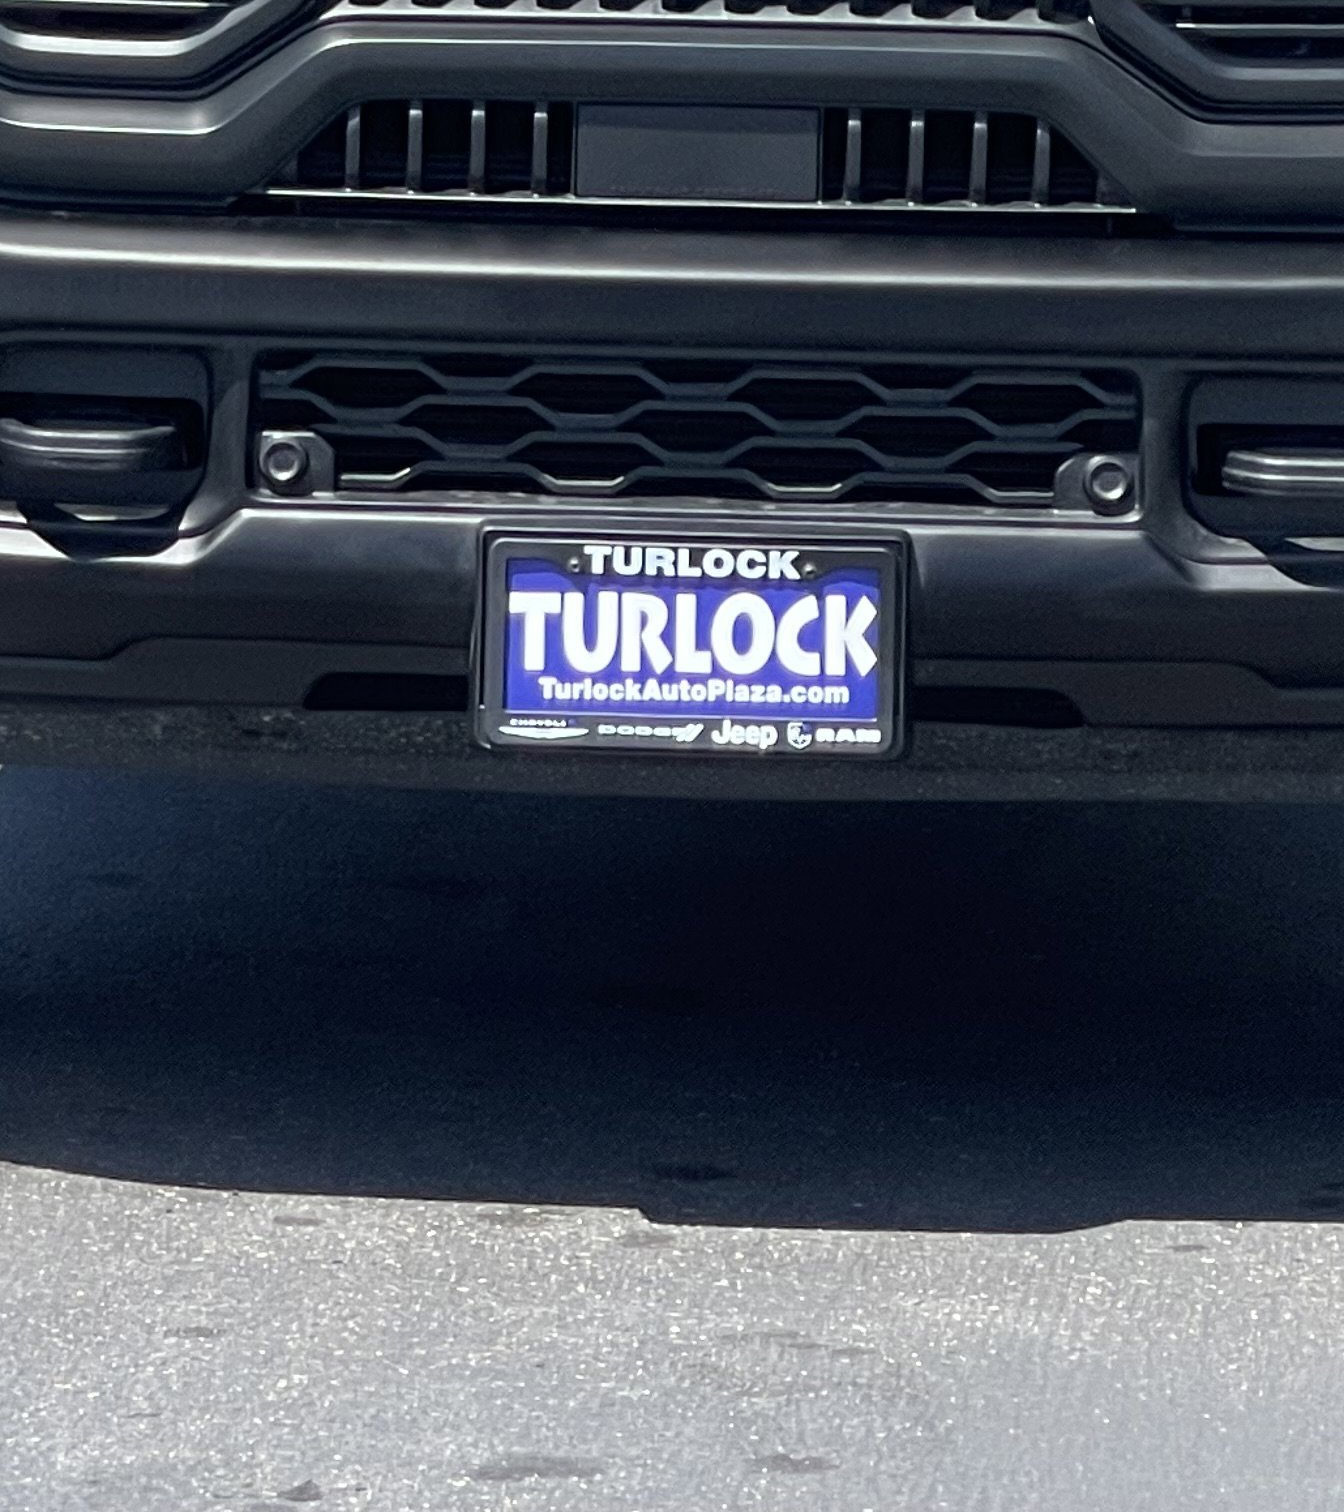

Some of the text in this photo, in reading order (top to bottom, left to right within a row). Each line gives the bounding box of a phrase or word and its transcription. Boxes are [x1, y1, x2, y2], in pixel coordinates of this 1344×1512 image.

[583, 545, 801, 580] TURLOCK
[508, 590, 878, 678] TURLOCK
[538, 676, 850, 705] TurlockAutoPlaza.com
[711, 719, 778, 750] Jeep
